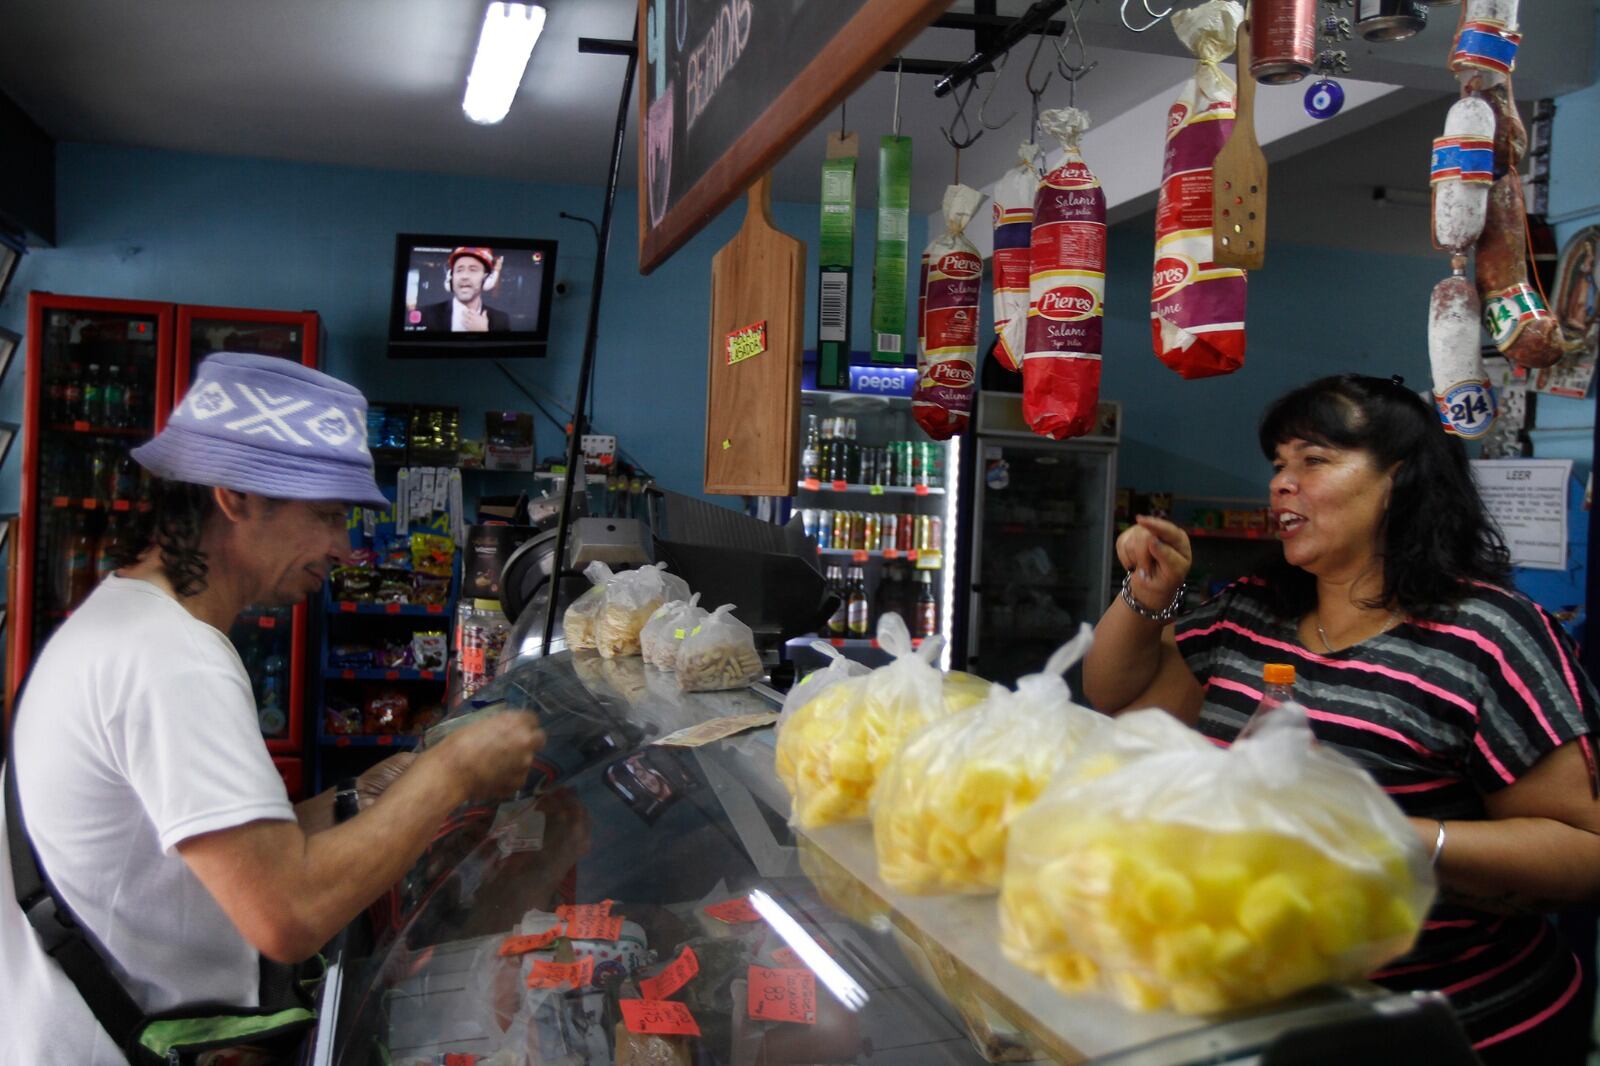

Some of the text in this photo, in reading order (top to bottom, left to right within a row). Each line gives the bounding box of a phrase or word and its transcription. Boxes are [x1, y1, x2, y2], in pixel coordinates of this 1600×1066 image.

[1055, 191, 1096, 209] Salame
[943, 255, 981, 271] Pieres
[1041, 292, 1091, 311] Pieres
[1047, 322, 1086, 338] Salame
[934, 364, 974, 380] Pieres
[858, 374, 906, 391] pepsi
[1450, 394, 1489, 425] 214
[1505, 469, 1532, 481] LEER
